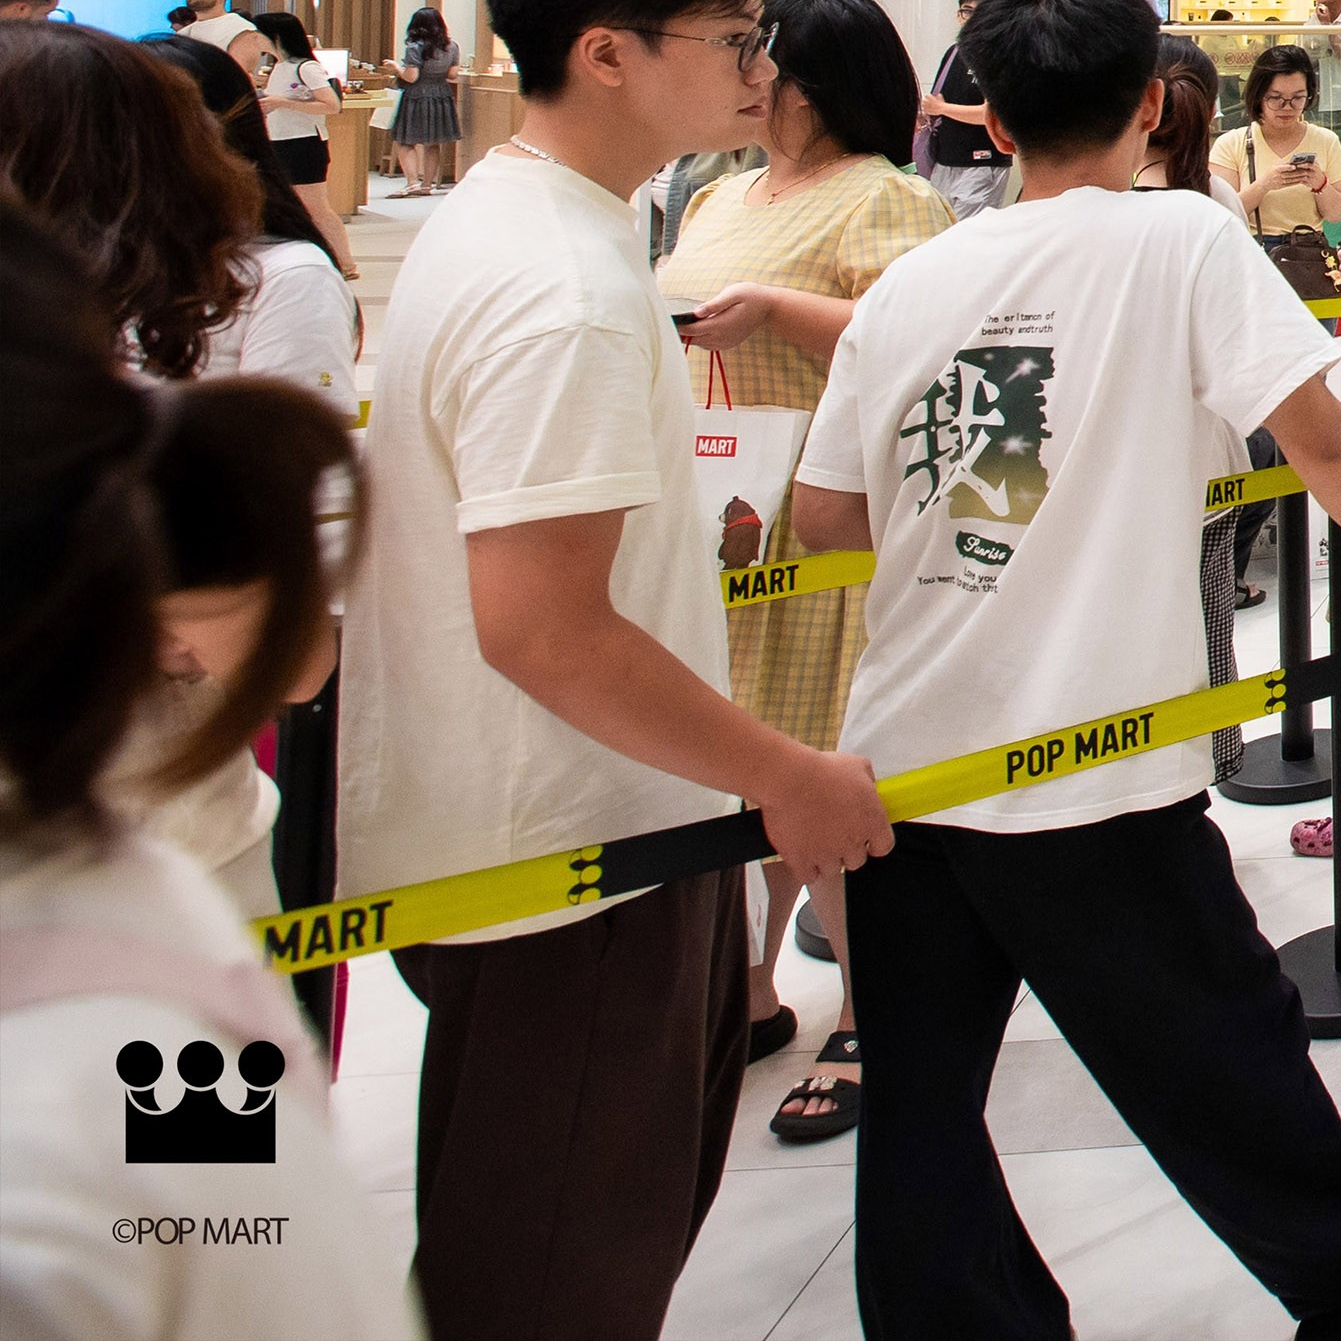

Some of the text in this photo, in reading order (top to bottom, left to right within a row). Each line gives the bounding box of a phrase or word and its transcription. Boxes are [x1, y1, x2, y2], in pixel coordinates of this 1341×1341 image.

[1045, 310, 1056, 320] of
[981, 326, 1015, 336] beauty
[697, 438, 735, 455] MART
[728, 564, 800, 603] MART
[917, 576, 936, 586] You
[978, 575, 997, 584] you
[1006, 711, 1155, 785] POP MART
[265, 900, 394, 963] MART
